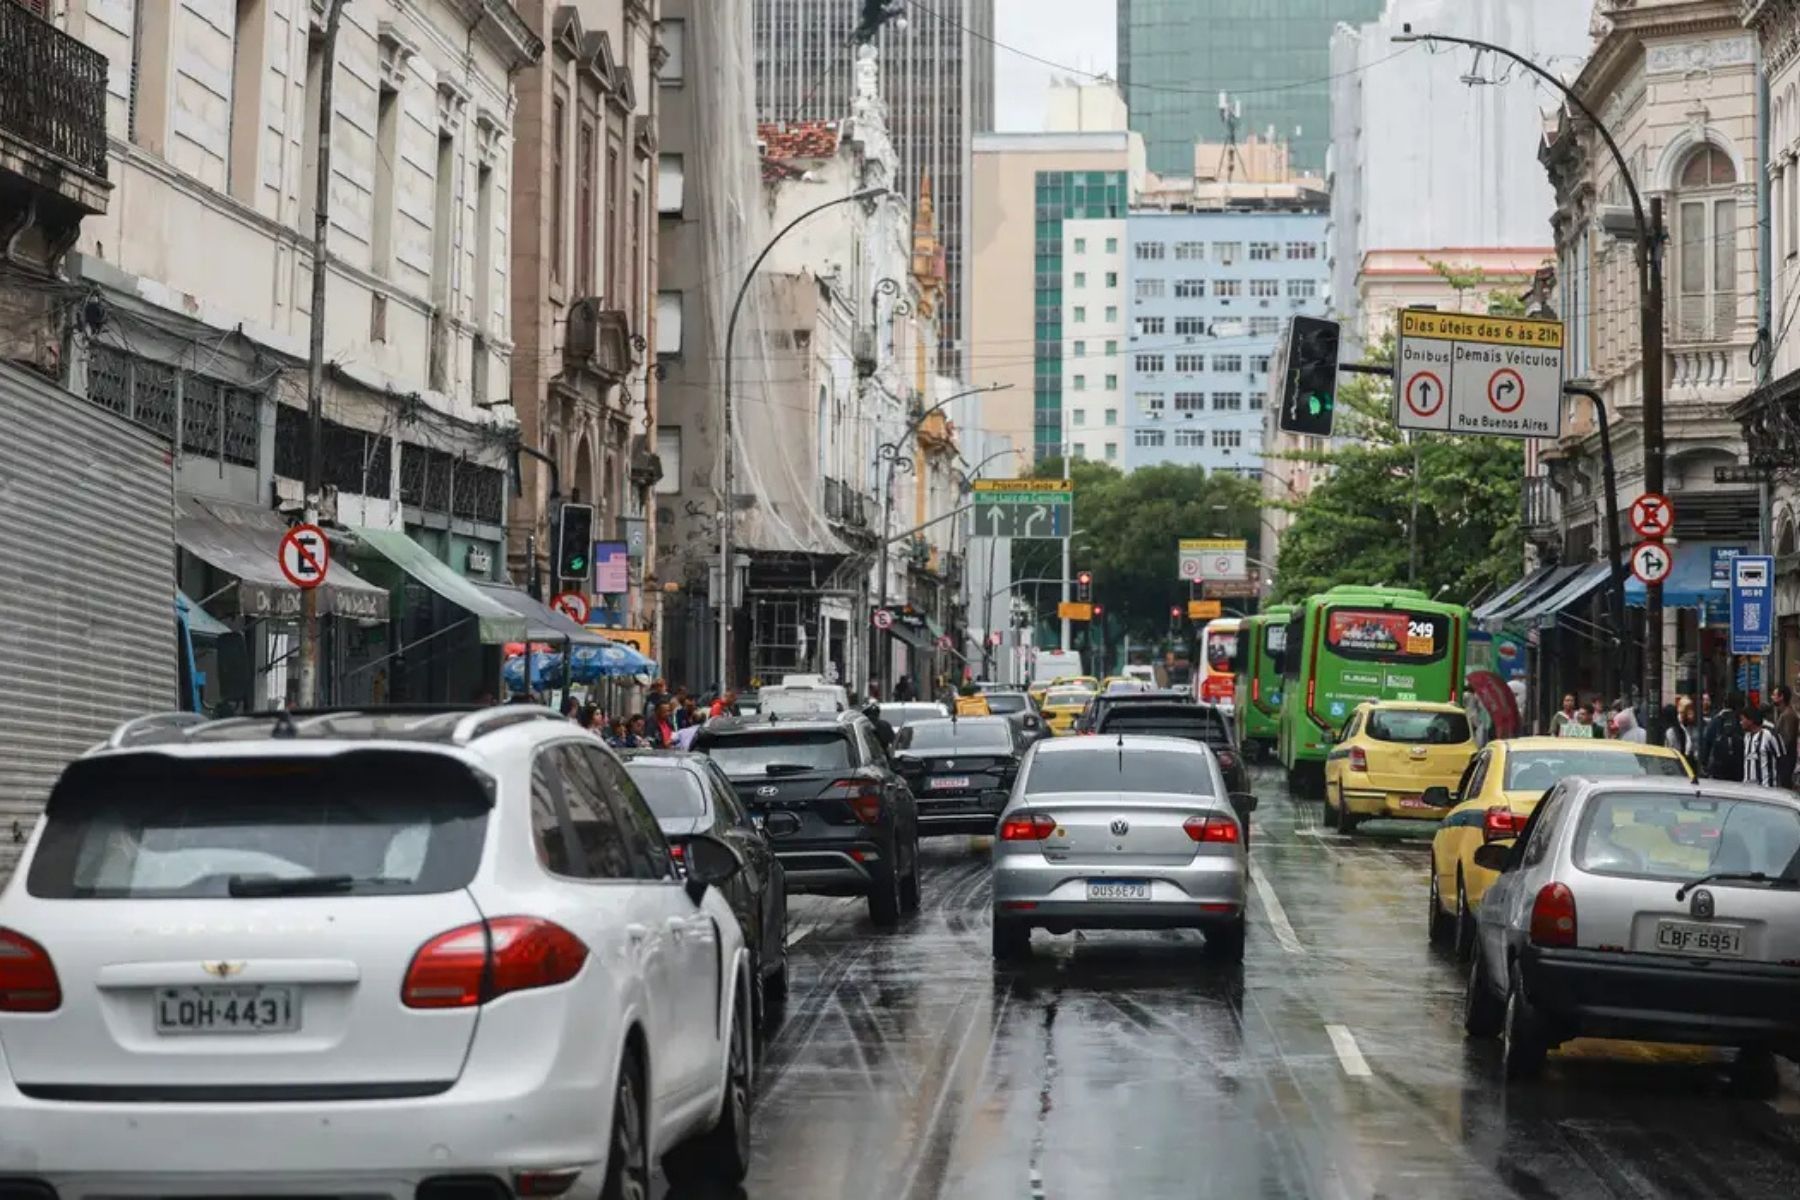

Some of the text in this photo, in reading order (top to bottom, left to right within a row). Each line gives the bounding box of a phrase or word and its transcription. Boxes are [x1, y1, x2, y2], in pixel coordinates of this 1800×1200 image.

[1405, 317, 1559, 342] Dias úteis das 6 às 21h
[1404, 345, 1449, 362] Ônibus
[1456, 347, 1559, 367] Demais Veículos
[1459, 414, 1548, 431] Rua Buenos Aires
[1407, 621, 1434, 638] 249
